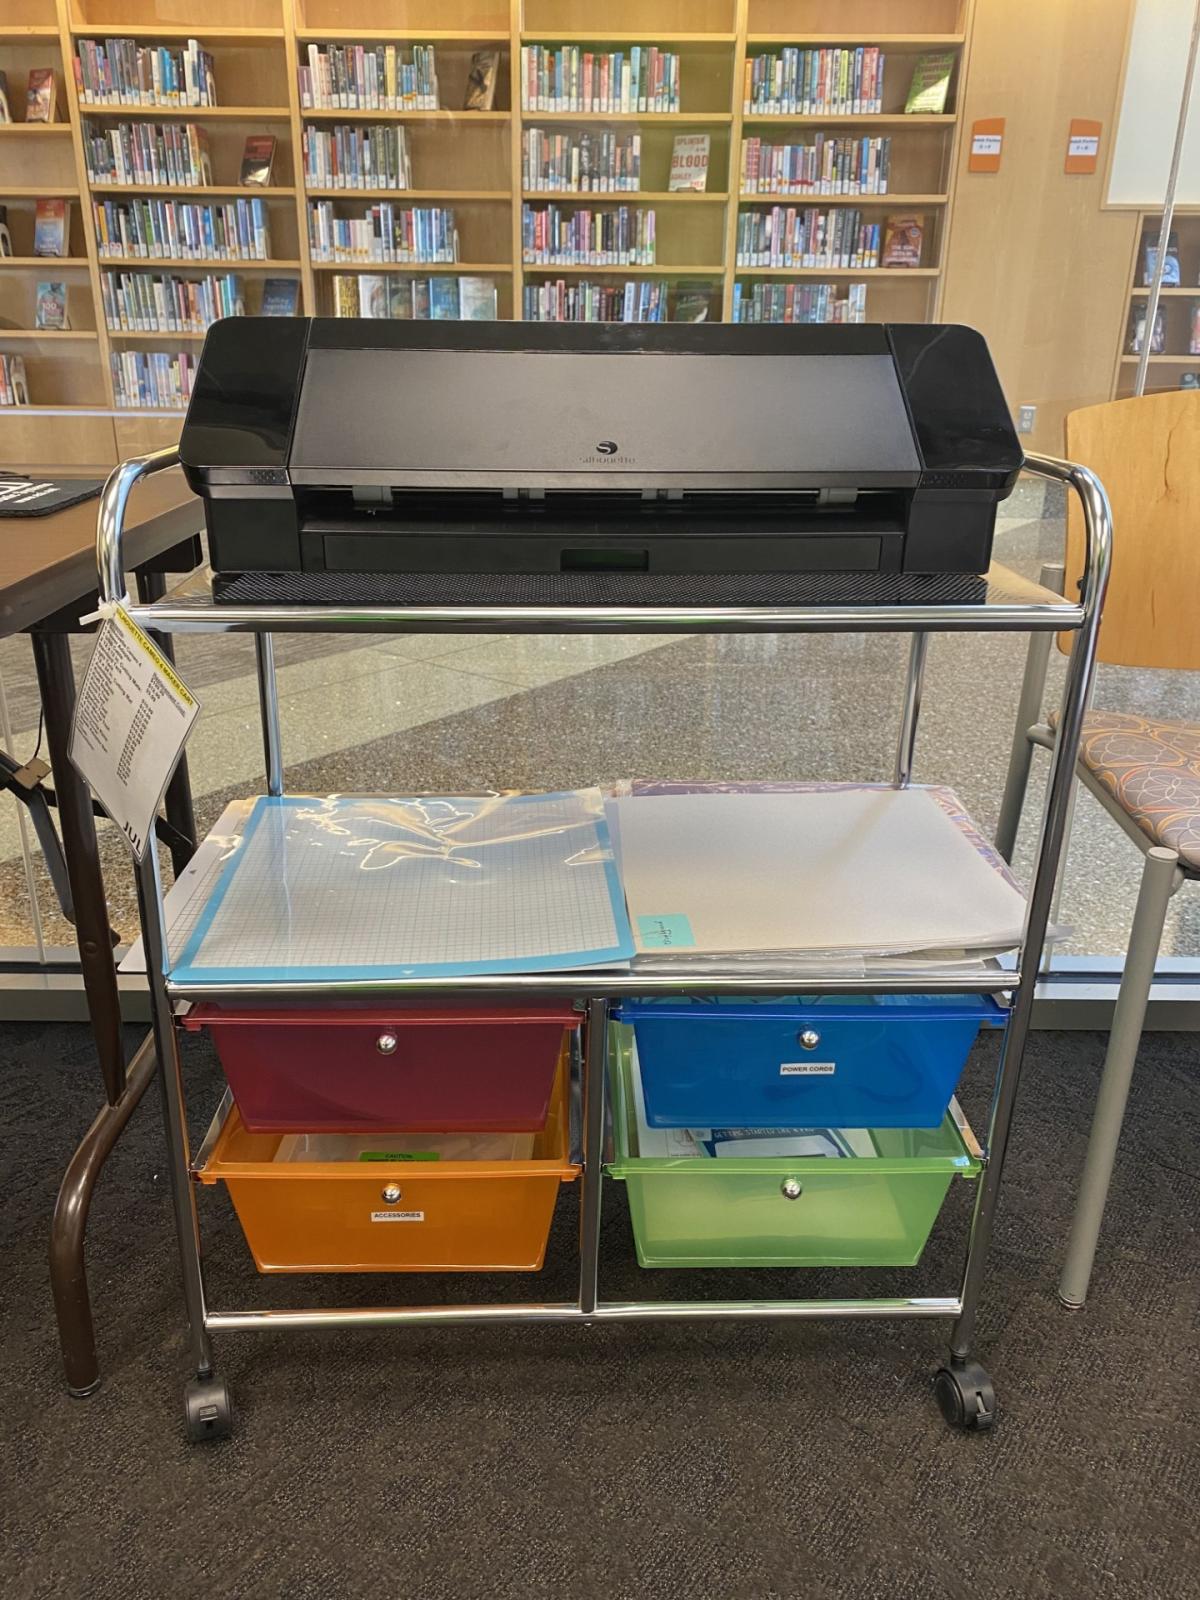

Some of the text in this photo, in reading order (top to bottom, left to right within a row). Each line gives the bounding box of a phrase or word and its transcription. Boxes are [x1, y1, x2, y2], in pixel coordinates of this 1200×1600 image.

[672, 155, 709, 168] BLOOD
[142, 640, 159, 665] CAMEO
[161, 665, 180, 691] MAKER
[179, 687, 193, 707] CART
[122, 820, 142, 854] JUL
